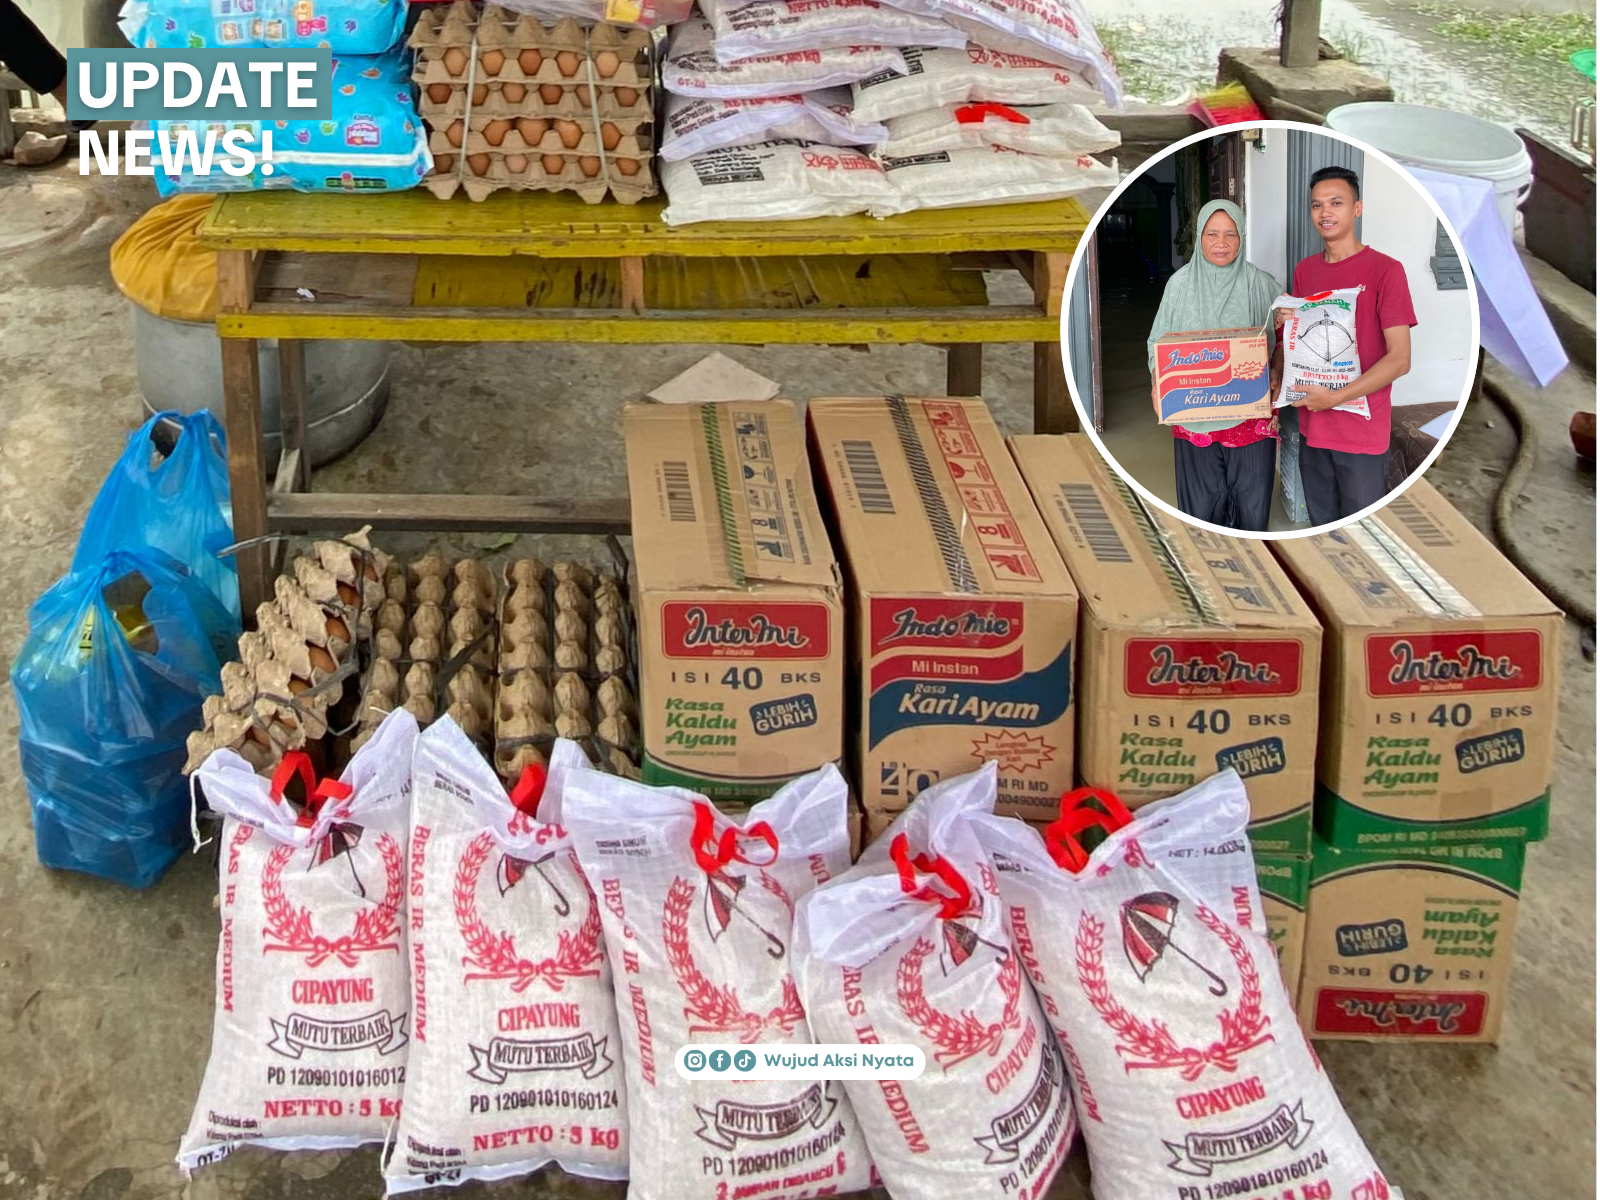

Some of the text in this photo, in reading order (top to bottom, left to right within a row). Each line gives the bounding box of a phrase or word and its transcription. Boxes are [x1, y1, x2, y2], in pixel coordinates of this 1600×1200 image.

[1289, 317, 1299, 351] BERAS IR
[1189, 377, 1211, 385] Instan
[1302, 371, 1332, 380] BRUTTO
[1184, 393, 1240, 406] Kari Ayam
[912, 660, 979, 675] Mi Instan
[721, 667, 763, 690] 40
[781, 672, 821, 684] BKS
[914, 683, 946, 694] Rasa
[665, 698, 724, 711] Rasa
[763, 701, 799, 718] LEBIH
[898, 693, 1039, 723] Kari Ayam
[1428, 703, 1472, 727] 40
[1491, 705, 1532, 719] BKS
[666, 712, 737, 729] Kaldu
[756, 708, 814, 733] GURIH
[1187, 709, 1230, 734] 40
[1249, 714, 1291, 726] BKS
[665, 730, 737, 749] Ayam
[1120, 732, 1183, 747] Rasa
[1367, 736, 1430, 749] Rasa
[1470, 736, 1508, 755] LEBIH
[1119, 748, 1196, 767] Kaldu
[1230, 745, 1267, 764] LEBIH
[1236, 753, 1282, 775] URIH
[1366, 750, 1441, 767] Kaldu
[1460, 743, 1521, 770] GURIH
[1012, 779, 1049, 792] RI MD
[1118, 768, 1195, 787] Ayam
[1364, 769, 1439, 789] Ayam
[226, 884, 237, 907] IR
[1423, 909, 1501, 928] Ayam
[410, 825, 431, 1043] BERAS IR MEDIUM
[1422, 927, 1499, 945] Kaldu
[222, 919, 234, 1012] MEDIUM
[1328, 964, 1371, 978] BKS
[1390, 963, 1434, 984] 40
[292, 978, 374, 1005] CIPAYUNG
[498, 1003, 581, 1032] CIPAYUNG
[623, 949, 656, 1087] IR MEDIUM
[1010, 906, 1046, 984] BERAS
[1055, 1025, 1103, 1124] MEDIUM
[291, 1010, 390, 1045] MUTU TERBAIK
[495, 1038, 593, 1065] MUTU TERBAIK
[267, 1066, 406, 1087] PD 12090101016012
[470, 1094, 489, 1114] PD
[1176, 1076, 1266, 1119] CIPAYUNG
[264, 1099, 342, 1118] NETTO
[359, 1099, 372, 1117] 5
[722, 1106, 763, 1132] MUTU
[879, 1080, 930, 1154] EDIUM
[997, 1111, 1032, 1140] MUTU
[1193, 1111, 1293, 1158] MUTU TERBAIK
[473, 1125, 620, 1151] NETTO 5 kg
[703, 1156, 723, 1176] PD
[999, 1174, 1019, 1195] PD
[1178, 1186, 1201, 1200] PD
